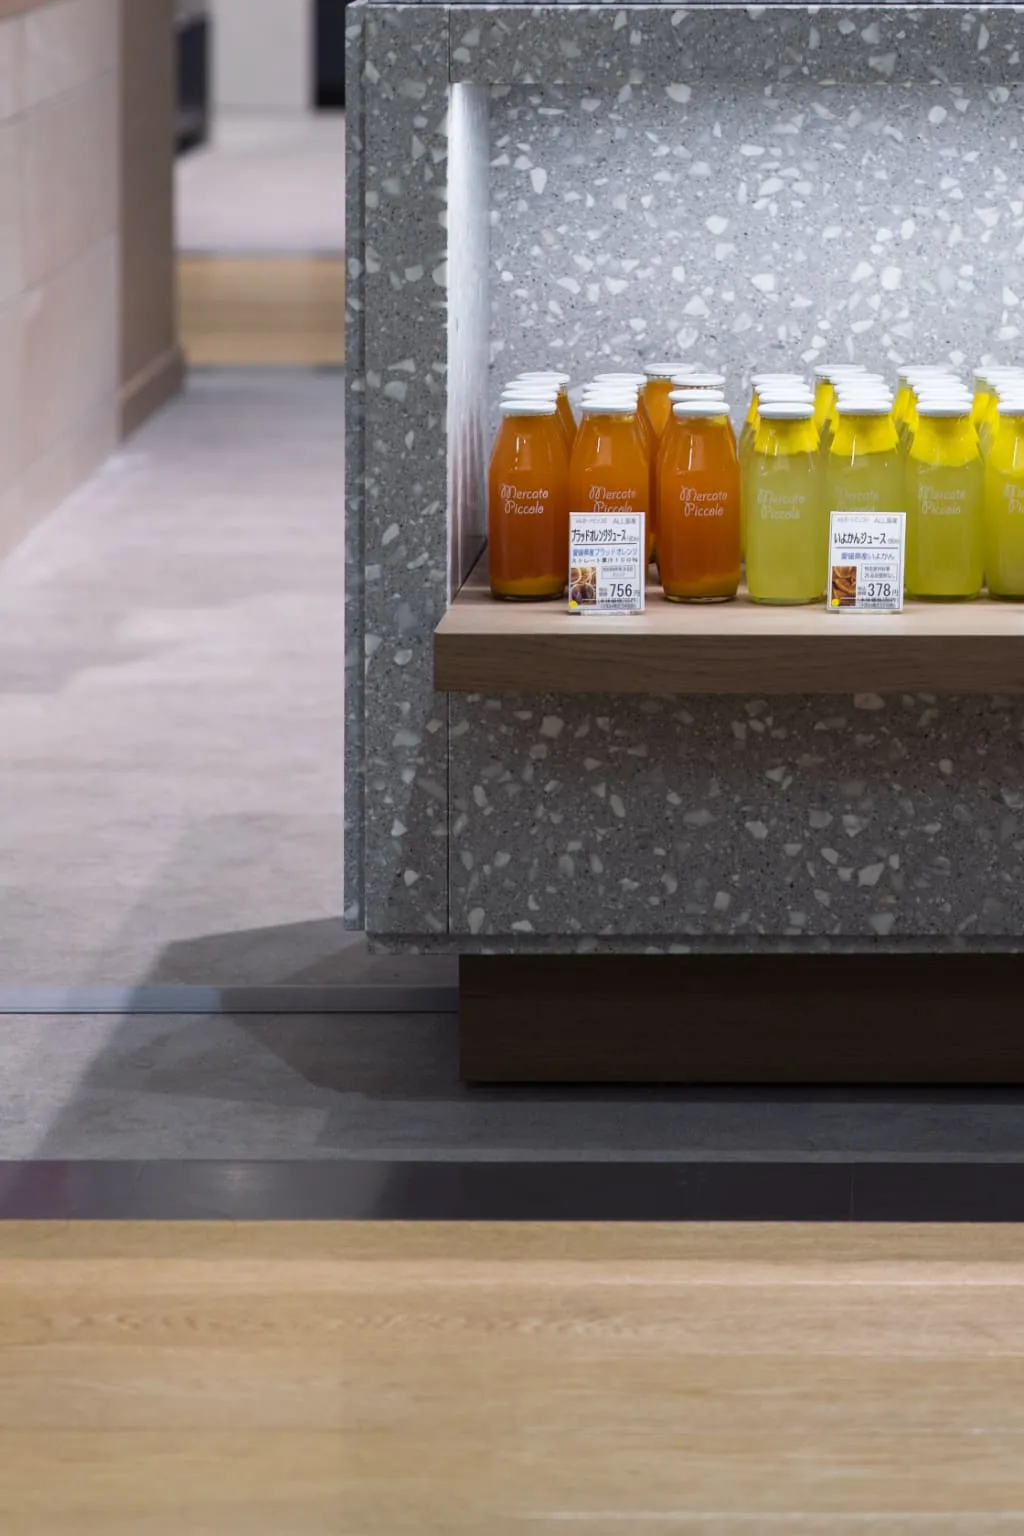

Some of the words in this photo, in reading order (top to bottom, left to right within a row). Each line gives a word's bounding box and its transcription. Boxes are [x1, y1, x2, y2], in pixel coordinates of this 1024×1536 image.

[501, 483, 549, 500] Mercato
[589, 484, 636, 500] Mercato
[679, 485, 728, 502] Mercato
[504, 500, 544, 515] Piccolo
[684, 501, 724, 517] Piccolo
[572, 529, 626, 542] ブラッドオレンジジュース
[834, 532, 886, 544] いよかんジュース
